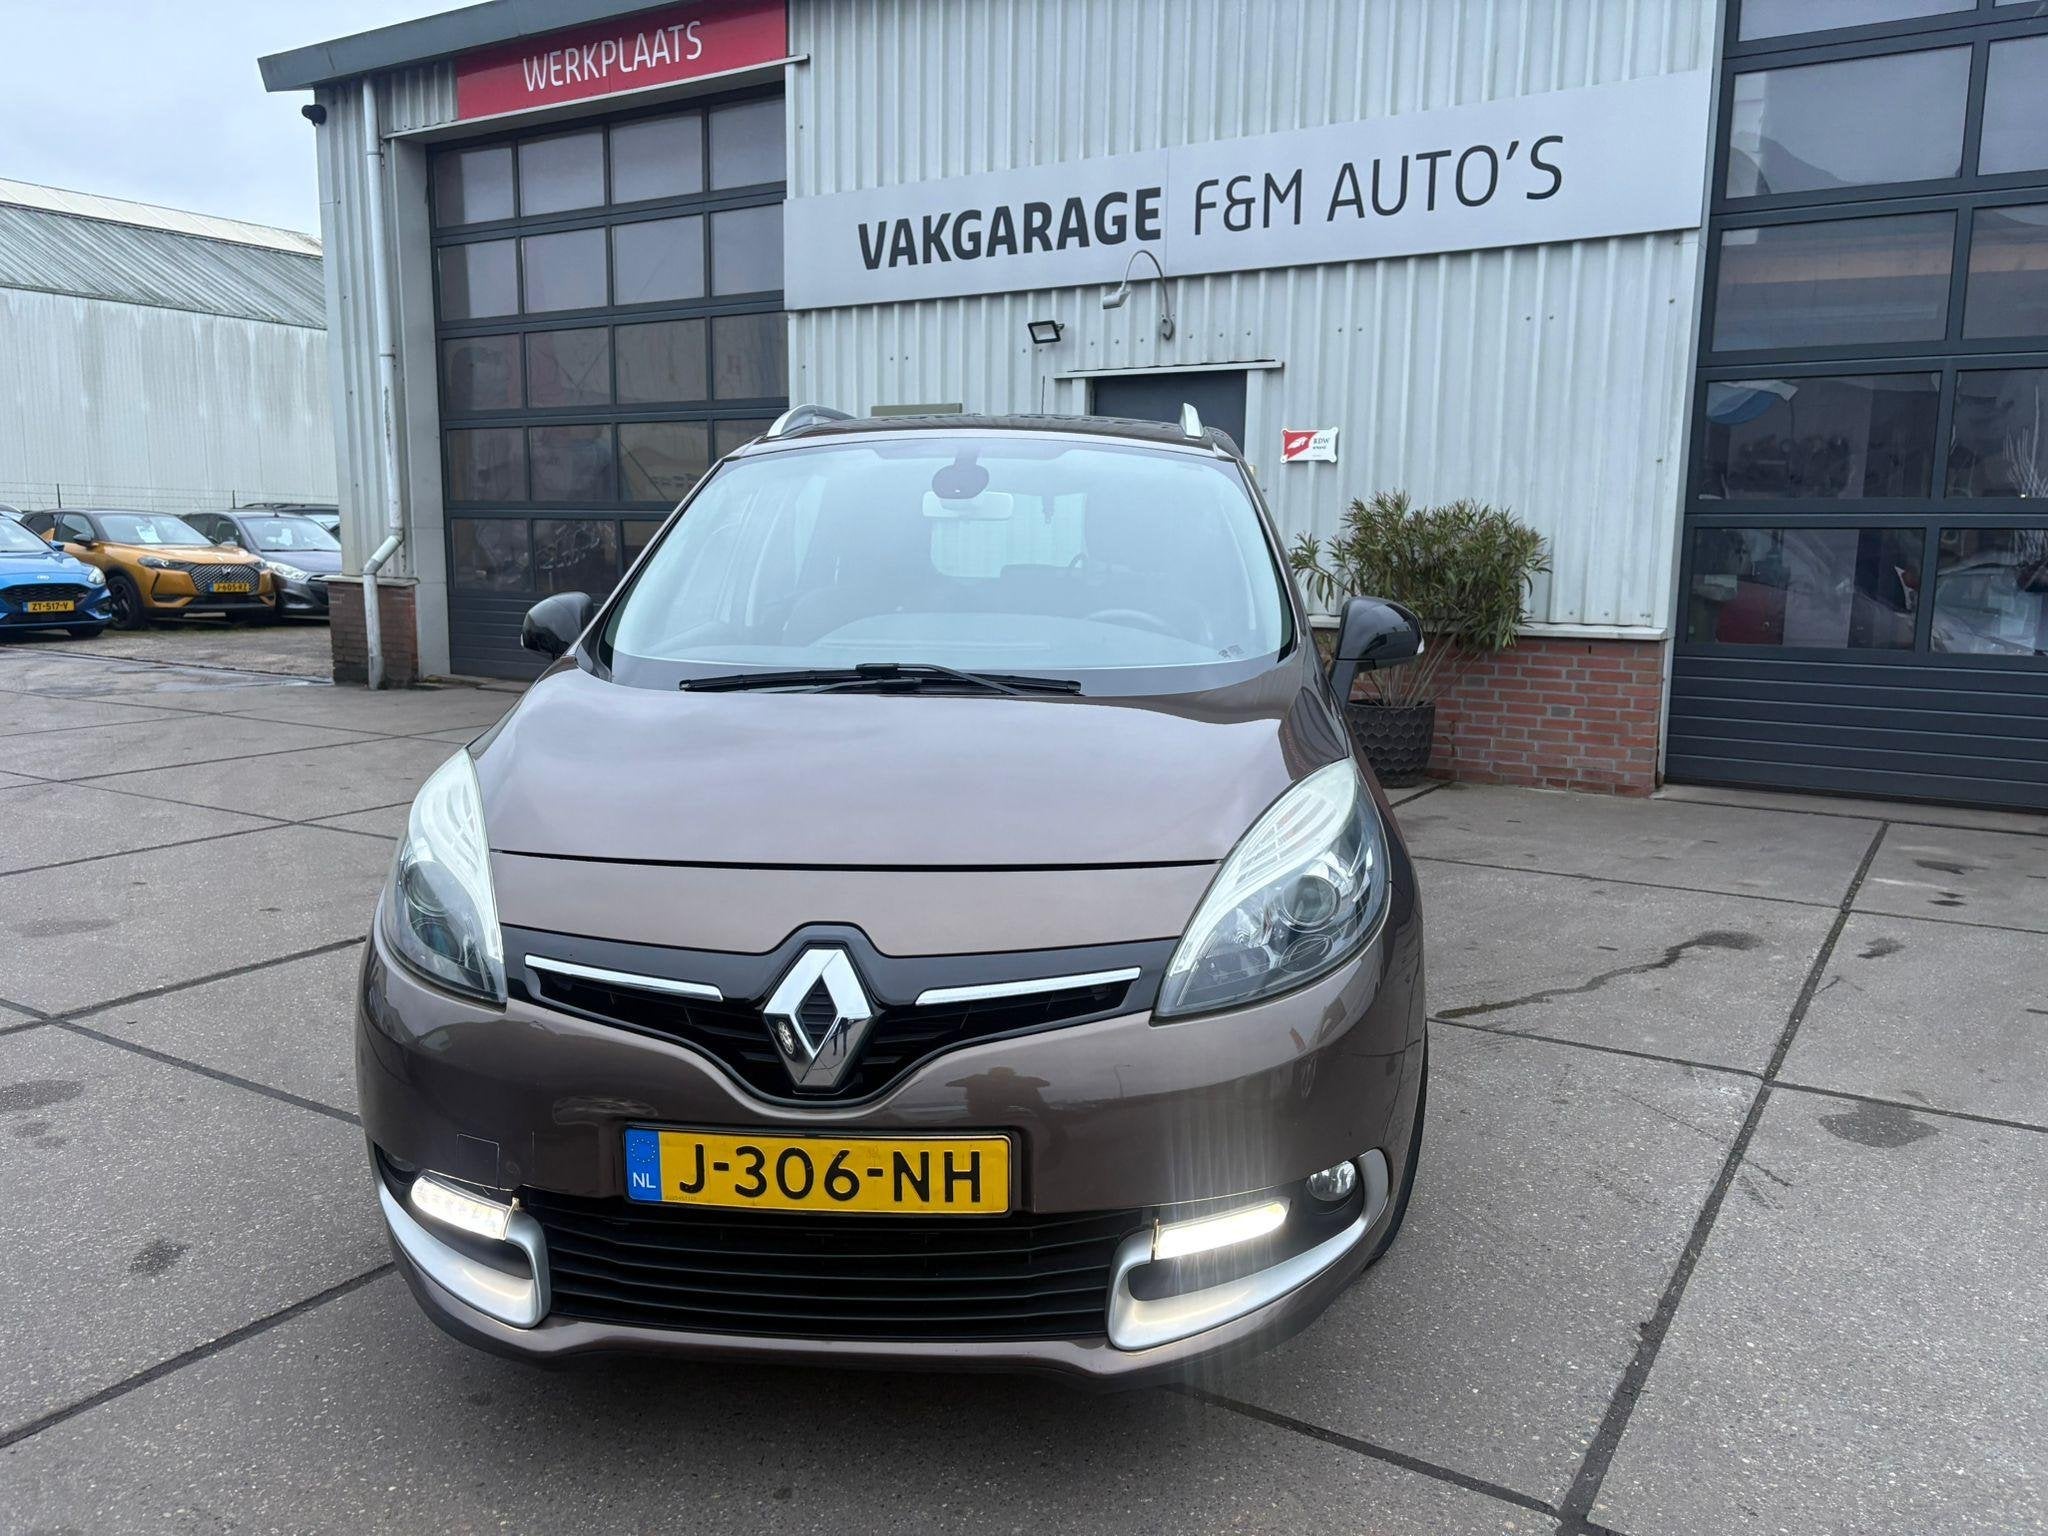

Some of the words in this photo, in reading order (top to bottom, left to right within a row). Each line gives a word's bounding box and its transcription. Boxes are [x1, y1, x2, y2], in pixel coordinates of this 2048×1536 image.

[522, 20, 703, 92] WERKPLAATS
[857, 186, 1162, 271] VAKGARAGE
[1194, 168, 1302, 236] F&M
[1327, 134, 1565, 222] AUTO'S
[31, 602, 69, 611] ZT-517-V
[632, 1172, 657, 1189] NL
[679, 1143, 982, 1203] J-306-NH
